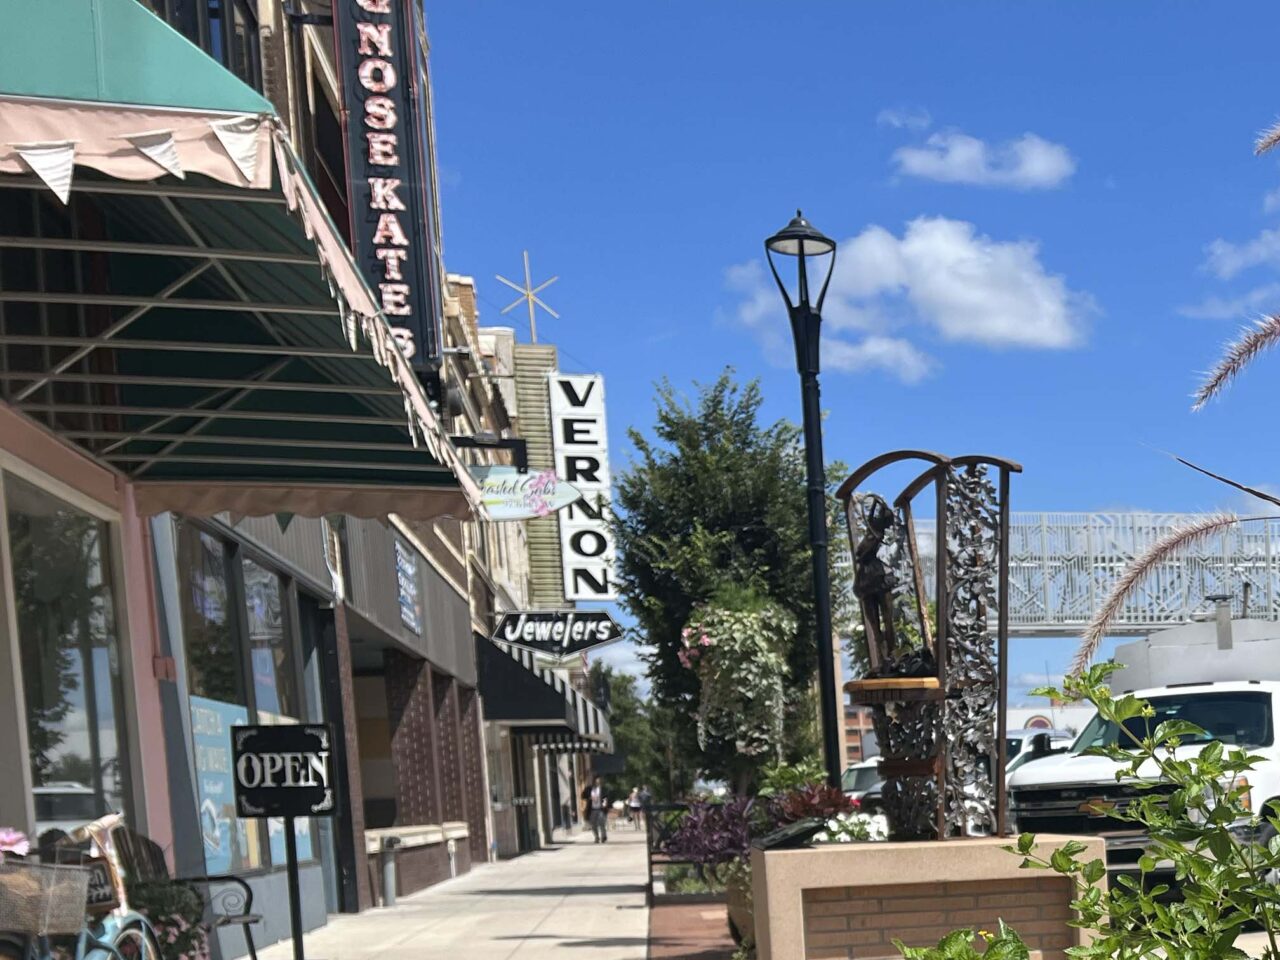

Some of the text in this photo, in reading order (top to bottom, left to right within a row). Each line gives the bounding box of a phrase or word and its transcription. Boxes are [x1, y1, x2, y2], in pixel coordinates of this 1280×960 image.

[356, 22, 400, 167] NOSE
[368, 177, 416, 362] KATES
[557, 380, 609, 594] VERNON
[504, 613, 612, 648] Jewelers
[236, 751, 330, 789] OPEN
